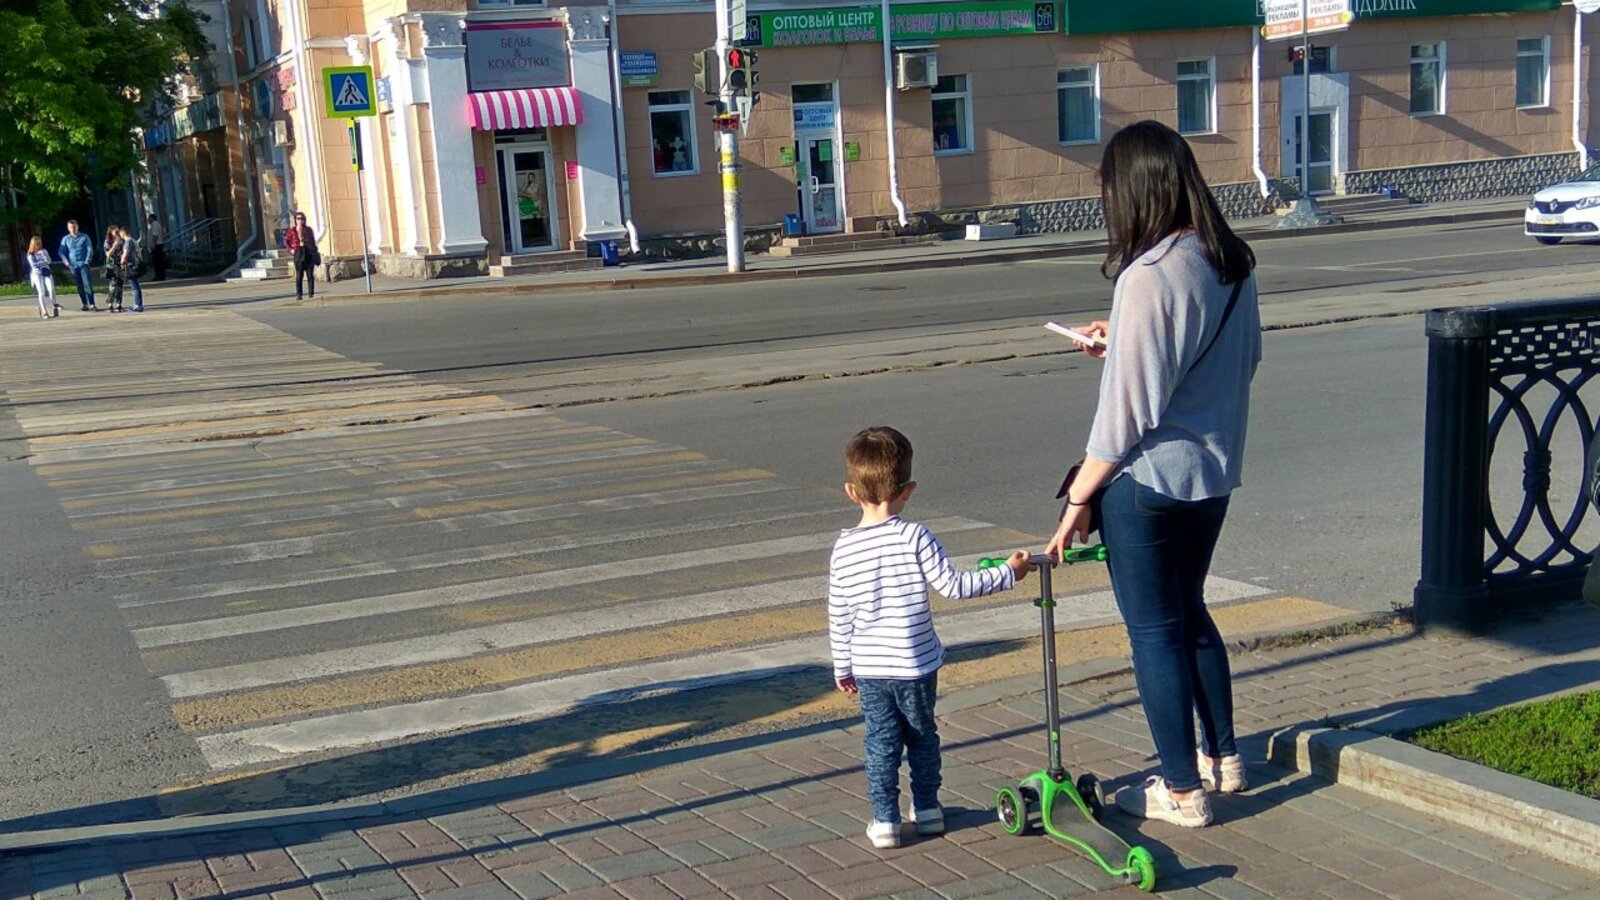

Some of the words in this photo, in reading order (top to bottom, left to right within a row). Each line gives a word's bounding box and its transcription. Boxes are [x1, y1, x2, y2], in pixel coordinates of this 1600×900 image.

[1268, 11, 1299, 22] РЕКЛАМЫ
[1311, 4, 1343, 15] РЕКЛАМЫ
[773, 11, 835, 30] ОПТОВЫЙ
[838, 12, 875, 27] ЦЕНТР
[896, 13, 938, 35] РОЗНИЦУ
[940, 12, 954, 31] ПО
[956, 10, 1000, 30] ОПТОВЫМ
[500, 37, 534, 48] БЕЛЬЕ
[773, 29, 833, 46] КОЛГОТОК
[834, 29, 841, 41] И
[843, 26, 876, 41] БЕЛЬЯ
[488, 56, 550, 70] КОЛГОТКИ
